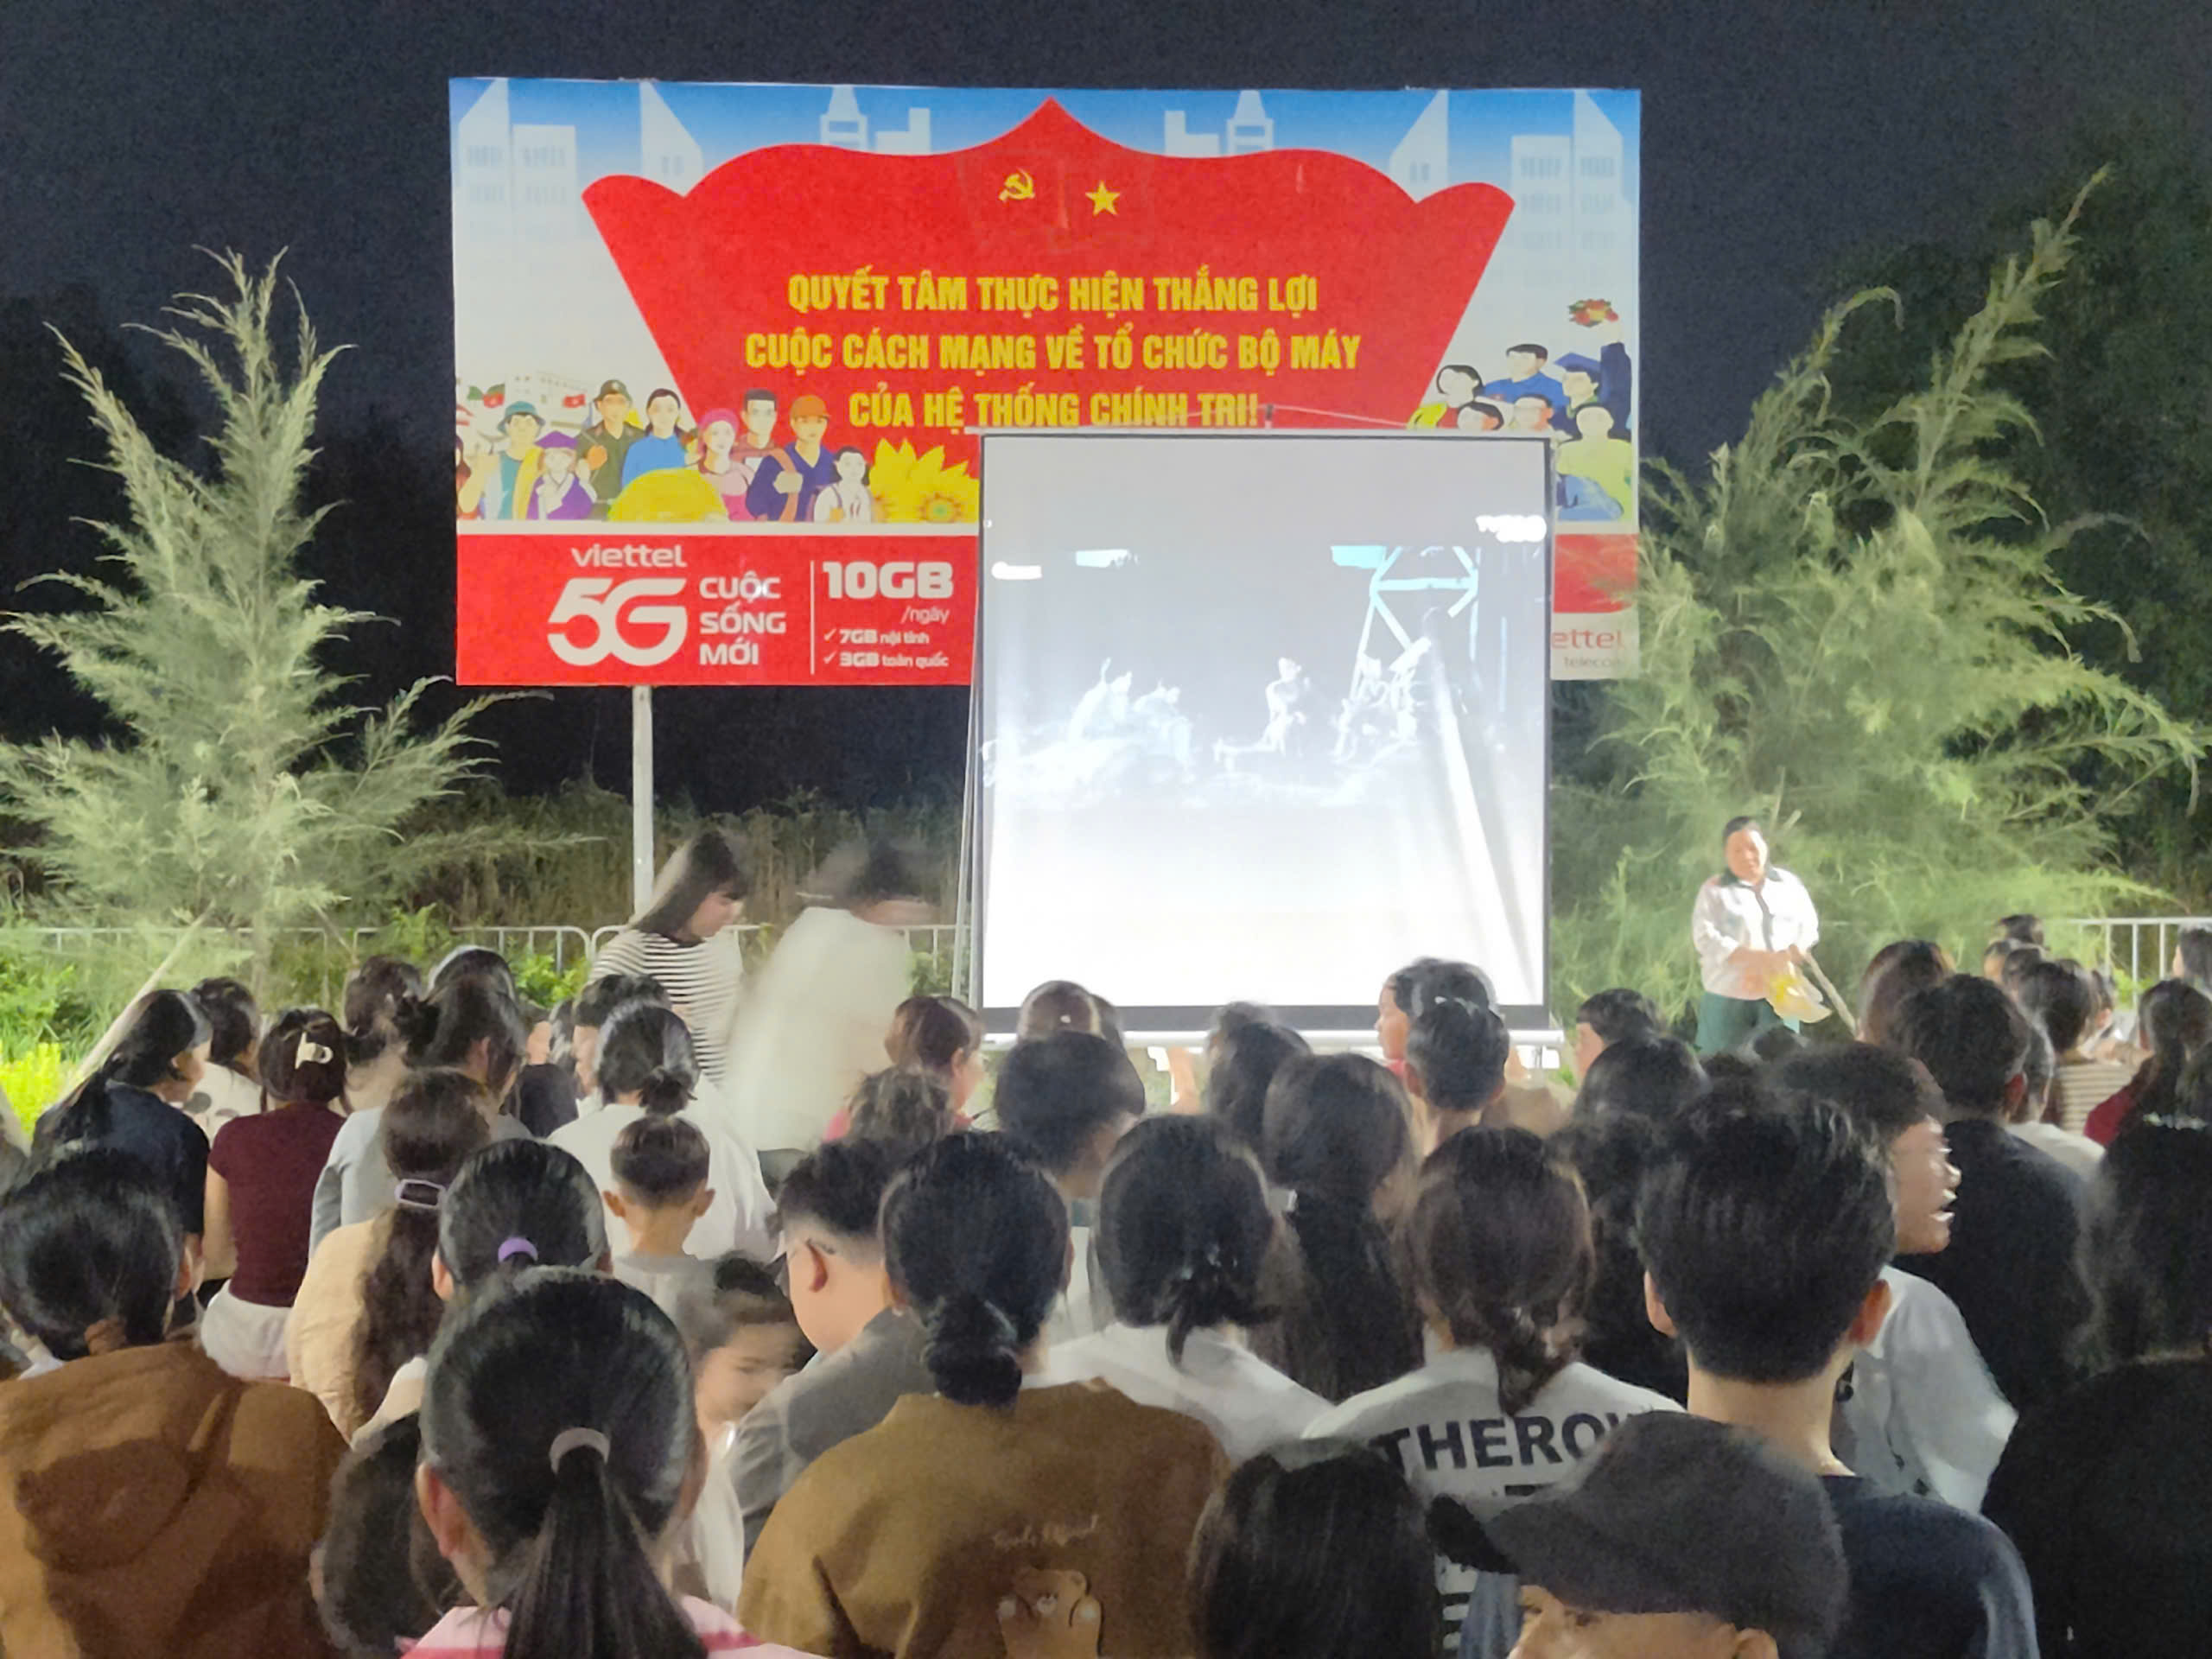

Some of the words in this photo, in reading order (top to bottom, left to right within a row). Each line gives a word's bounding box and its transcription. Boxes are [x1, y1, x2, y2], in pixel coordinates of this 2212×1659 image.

[788, 264, 889, 314] QUYẾT
[897, 269, 968, 310] TÂM
[976, 274, 1059, 319] THỰC
[1069, 270, 1144, 319] HIỆN
[1154, 264, 1259, 311] THẮNG
[1268, 273, 1318, 319] LỢI
[745, 326, 832, 376] CUỘC
[842, 326, 929, 369] CÁCH
[939, 334, 1036, 377] MẠNG
[1046, 323, 1084, 369] VỀ
[1094, 321, 1134, 369] TỔ
[1143, 327, 1228, 370] CHỨC
[1238, 327, 1281, 376] BỘ
[1291, 327, 1361, 370] MÁY
[849, 382, 914, 427] CỦA
[924, 386, 965, 435] HỆ
[974, 382, 1080, 428] THỐNG
[1090, 386, 1189, 427] CHÍNH
[570, 544, 688, 568] viettel
[698, 571, 781, 602] CUỘC
[822, 561, 955, 599] 10GB
[547, 577, 688, 667] 5G
[698, 601, 787, 635] SỐNG
[839, 628, 879, 644] 7GB
[698, 638, 760, 666] MỚI
